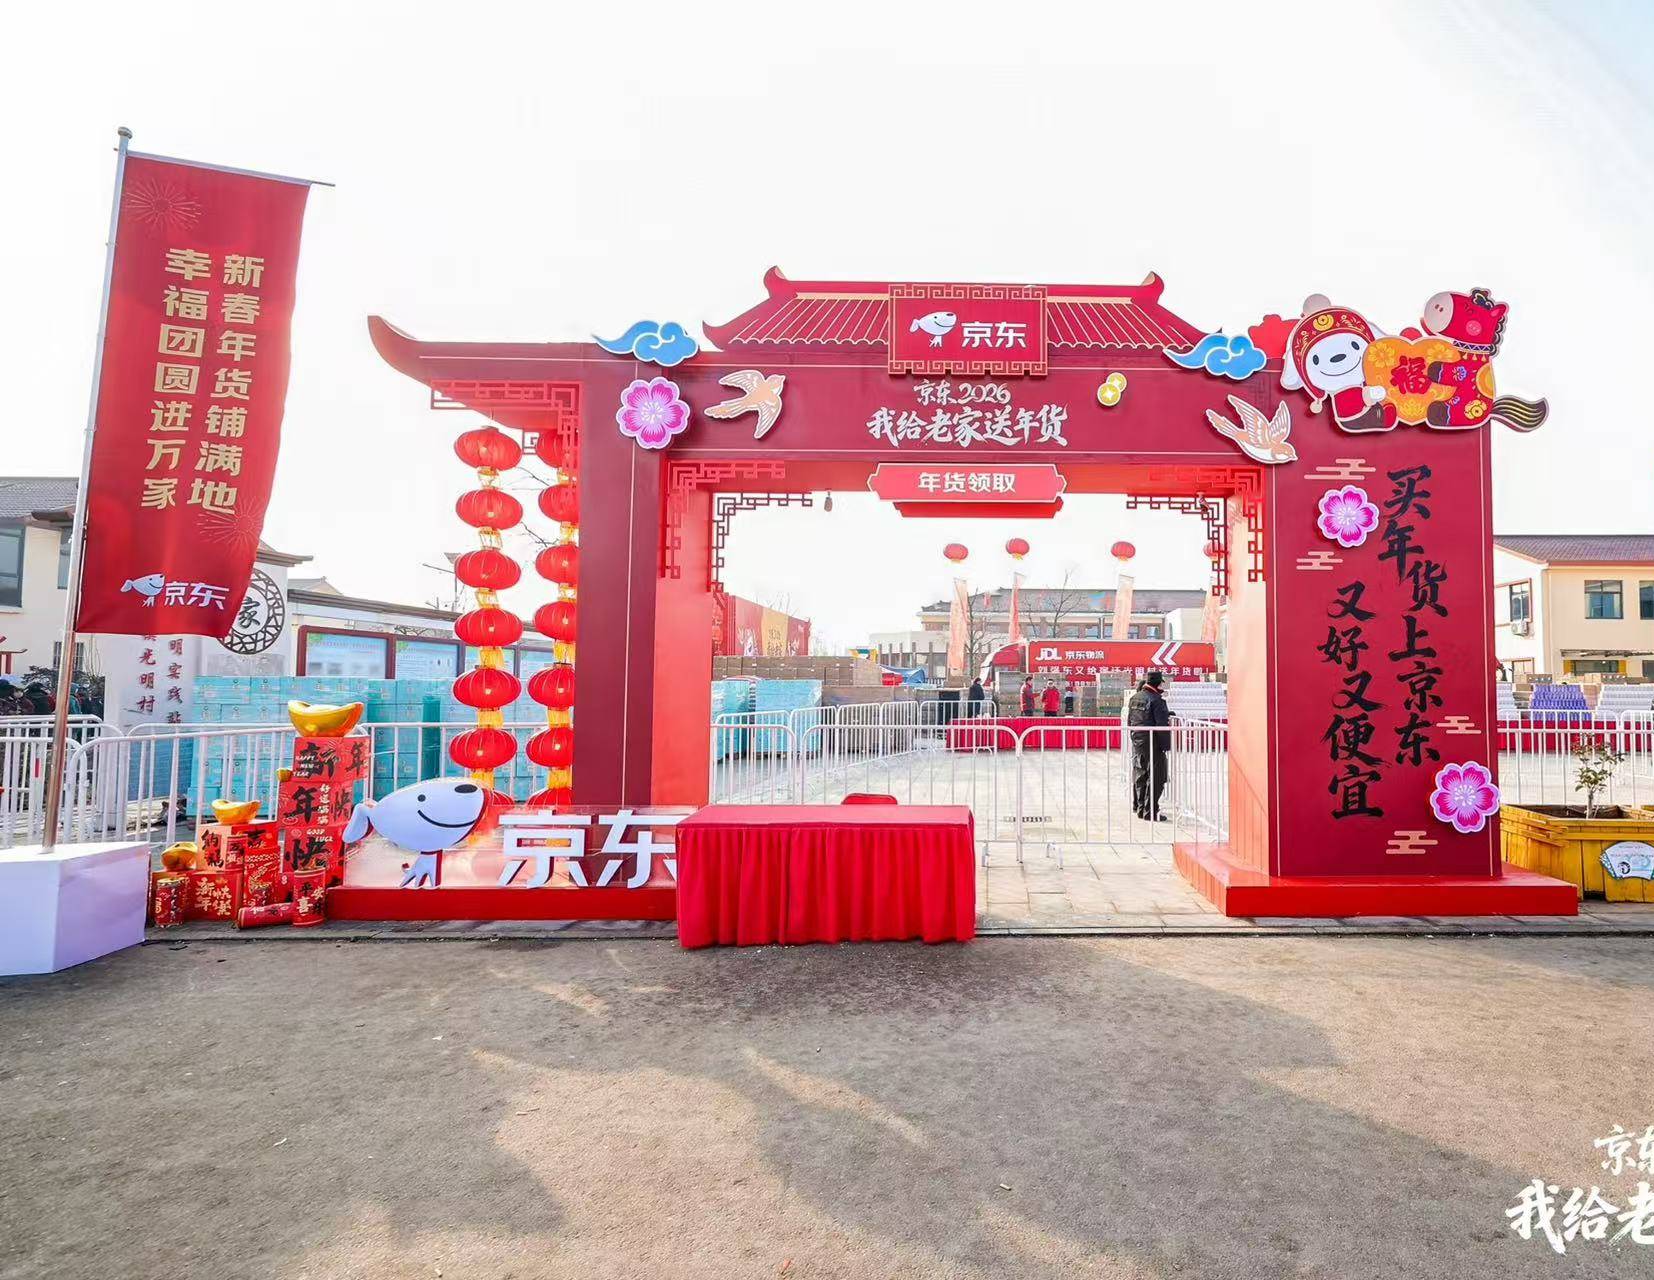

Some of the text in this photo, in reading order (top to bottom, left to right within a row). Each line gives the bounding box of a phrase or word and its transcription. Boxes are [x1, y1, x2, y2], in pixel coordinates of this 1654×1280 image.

[961, 321, 1027, 348] 京东
[141, 248, 211, 510] 幸福团圆进万家
[187, 254, 264, 514] 新春年货铺满地
[913, 379, 1011, 405] 京东2026
[1390, 356, 1429, 395] 福
[866, 404, 1069, 448] 我给老家送年货
[918, 472, 1016, 493] 年货领取
[164, 581, 230, 610] 京东
[1378, 464, 1448, 767] 买年货上京东
[1035, 647, 1105, 661] JDL 京东物流
[1316, 580, 1393, 820] 又好又便宜
[283, 786, 319, 824] 年
[498, 809, 684, 888] 京东
